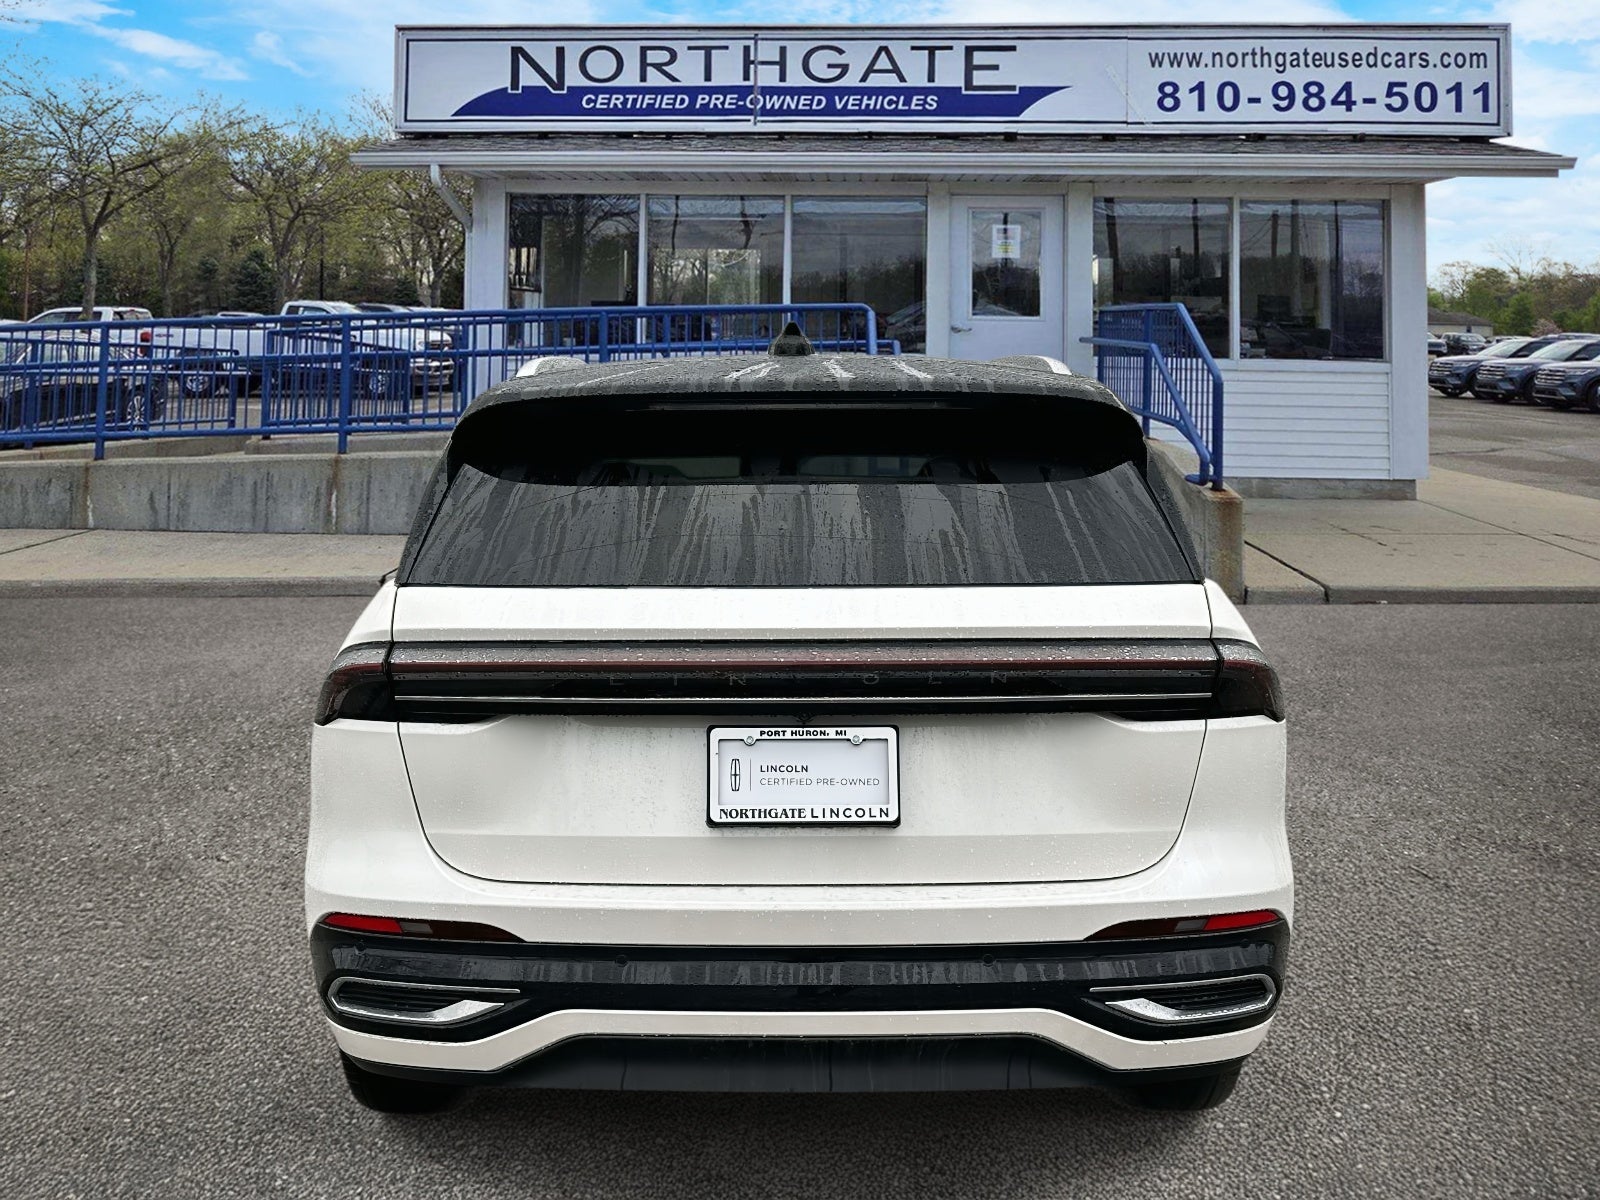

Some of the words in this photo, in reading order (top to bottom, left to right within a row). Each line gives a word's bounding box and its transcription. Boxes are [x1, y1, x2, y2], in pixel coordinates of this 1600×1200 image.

[1148, 46, 1488, 74] www.northgateusedcars.com
[509, 45, 1018, 94] NORTHGATE
[581, 93, 689, 110] CERTIFIED
[695, 93, 827, 111] PRE-OWNED
[834, 94, 939, 111] VEHICLES
[1156, 80, 1491, 114] 810-984-5011
[609, 673, 1008, 687] LINOLN
[759, 729, 788, 737] PORT
[835, 729, 847, 737] MI
[760, 764, 809, 773] LINCOLN
[759, 777, 813, 786] CERTIFIED
[816, 777, 880, 786] PRE-OWNED
[719, 808, 807, 819] NORTHGATE
[810, 807, 889, 819] LINCOLN
